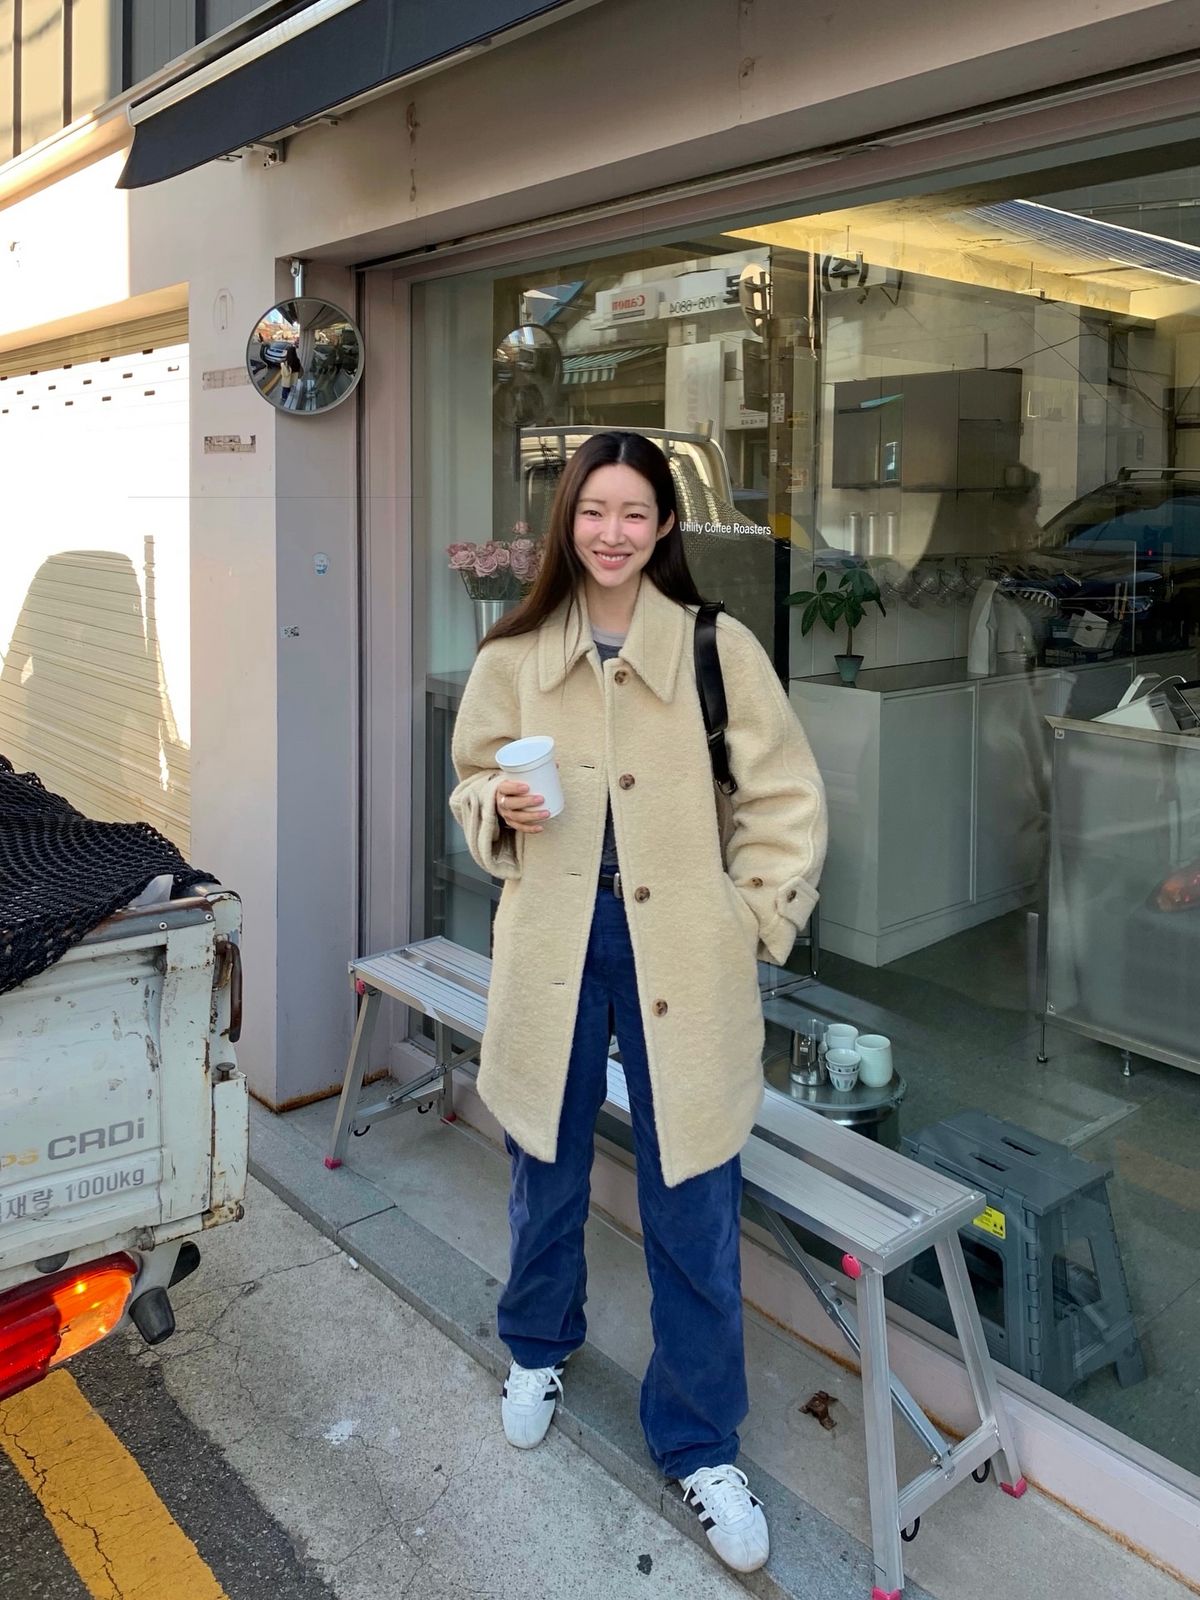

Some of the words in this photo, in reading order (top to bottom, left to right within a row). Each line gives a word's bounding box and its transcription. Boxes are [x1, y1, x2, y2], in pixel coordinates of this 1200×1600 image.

[680, 521, 704, 535] Utility
[704, 521, 732, 534] Coffee
[733, 522, 772, 535] Roasters
[48, 1117, 145, 1161] CRDi
[0, 1188, 54, 1223] 재량
[65, 1168, 145, 1203] 1000kg
